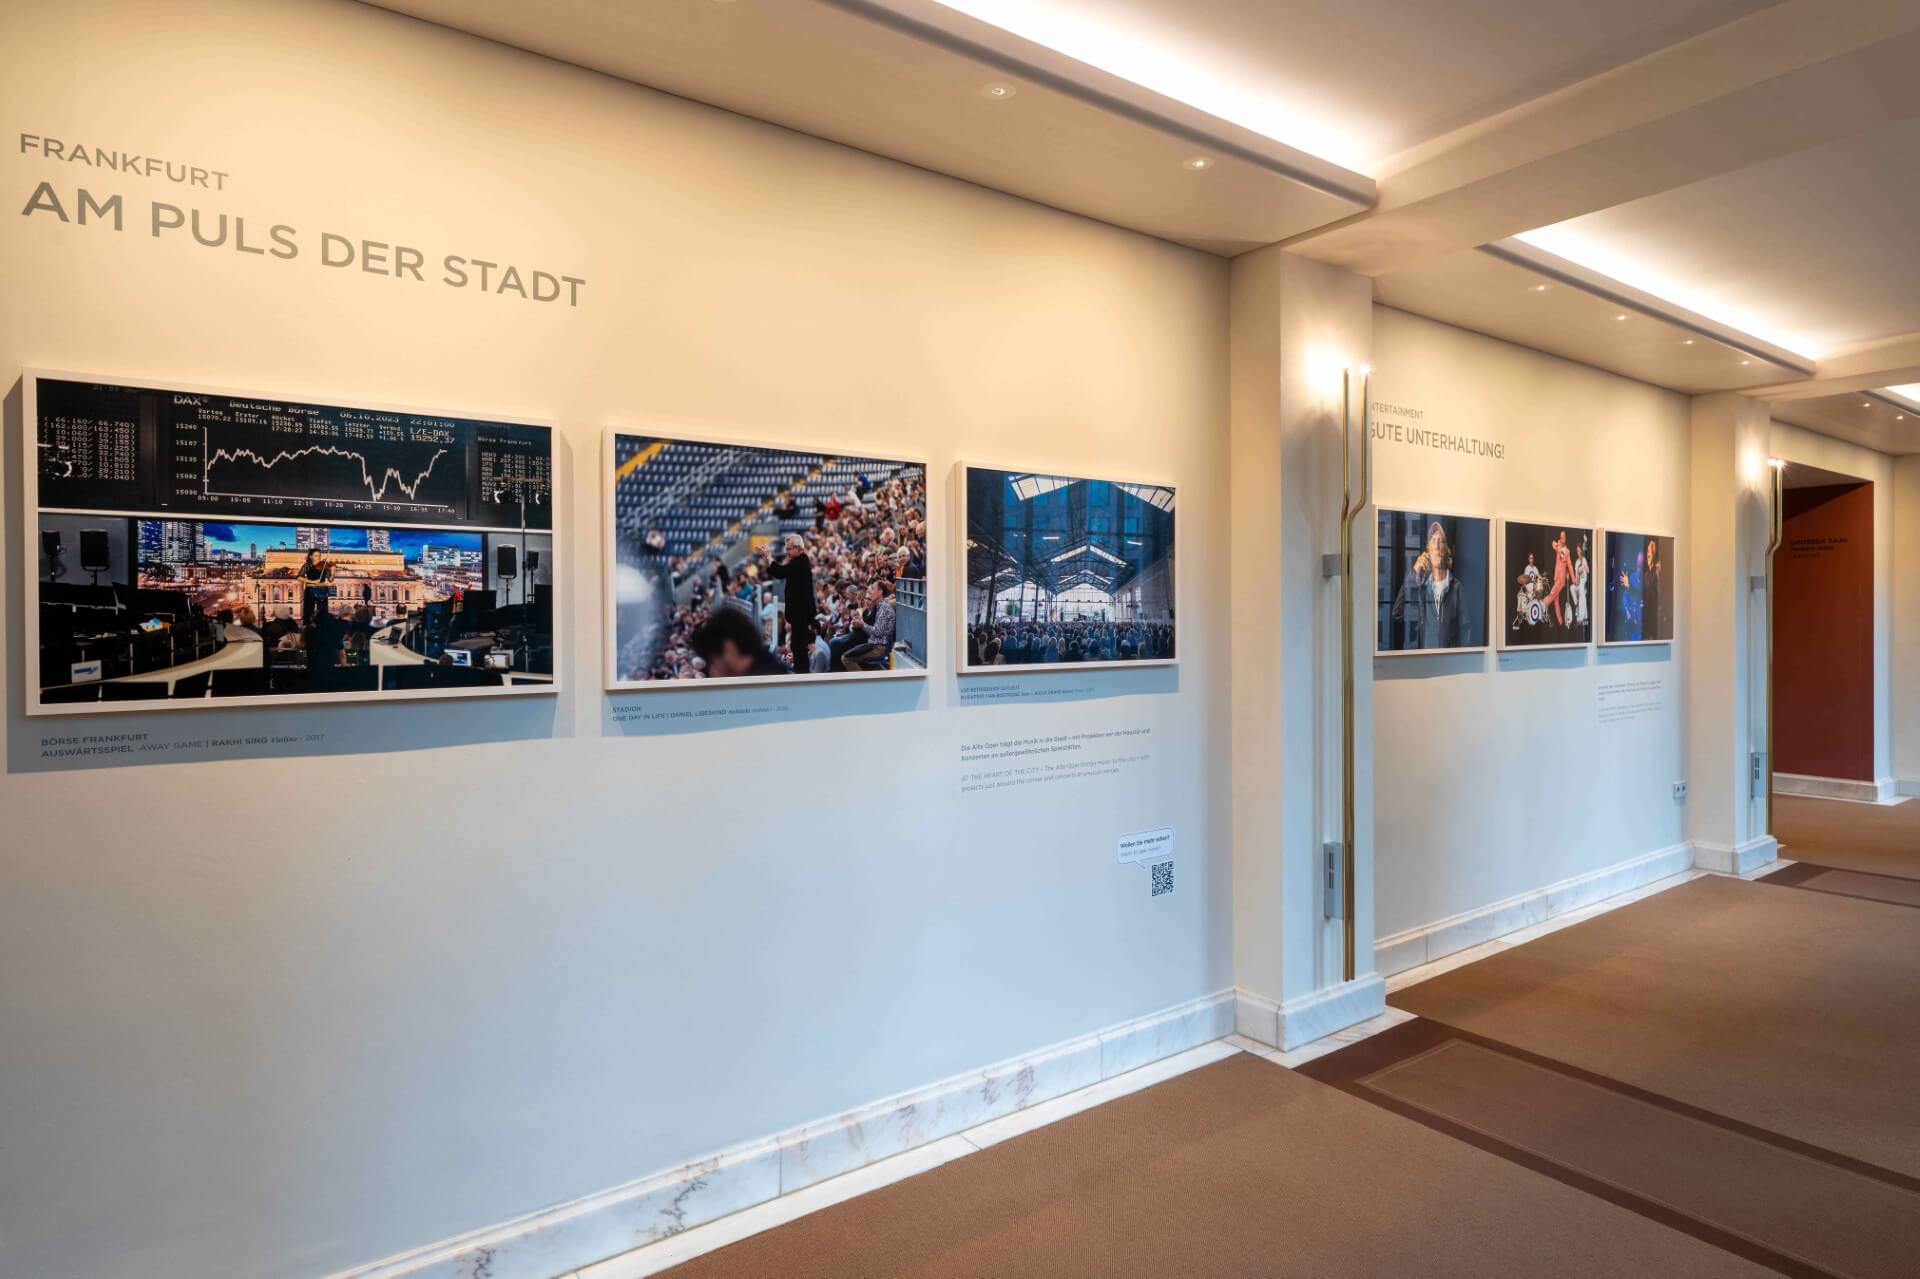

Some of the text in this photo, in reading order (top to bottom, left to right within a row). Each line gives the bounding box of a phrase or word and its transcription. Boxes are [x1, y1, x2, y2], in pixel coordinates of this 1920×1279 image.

[20, 133, 229, 190] FRANKFURT
[21, 181, 586, 307] AM PULS DER STADT
[1406, 427, 1505, 459] UNTERHALTUNG!
[41, 733, 148, 746] BÖRSE FRANKFURT
[41, 746, 134, 757] AUSWÄRTSSPIEL
[140, 742, 169, 751] AWAY
[173, 740, 202, 749] GAME
[212, 736, 242, 746] RAKHI
[245, 736, 268, 745] SING
